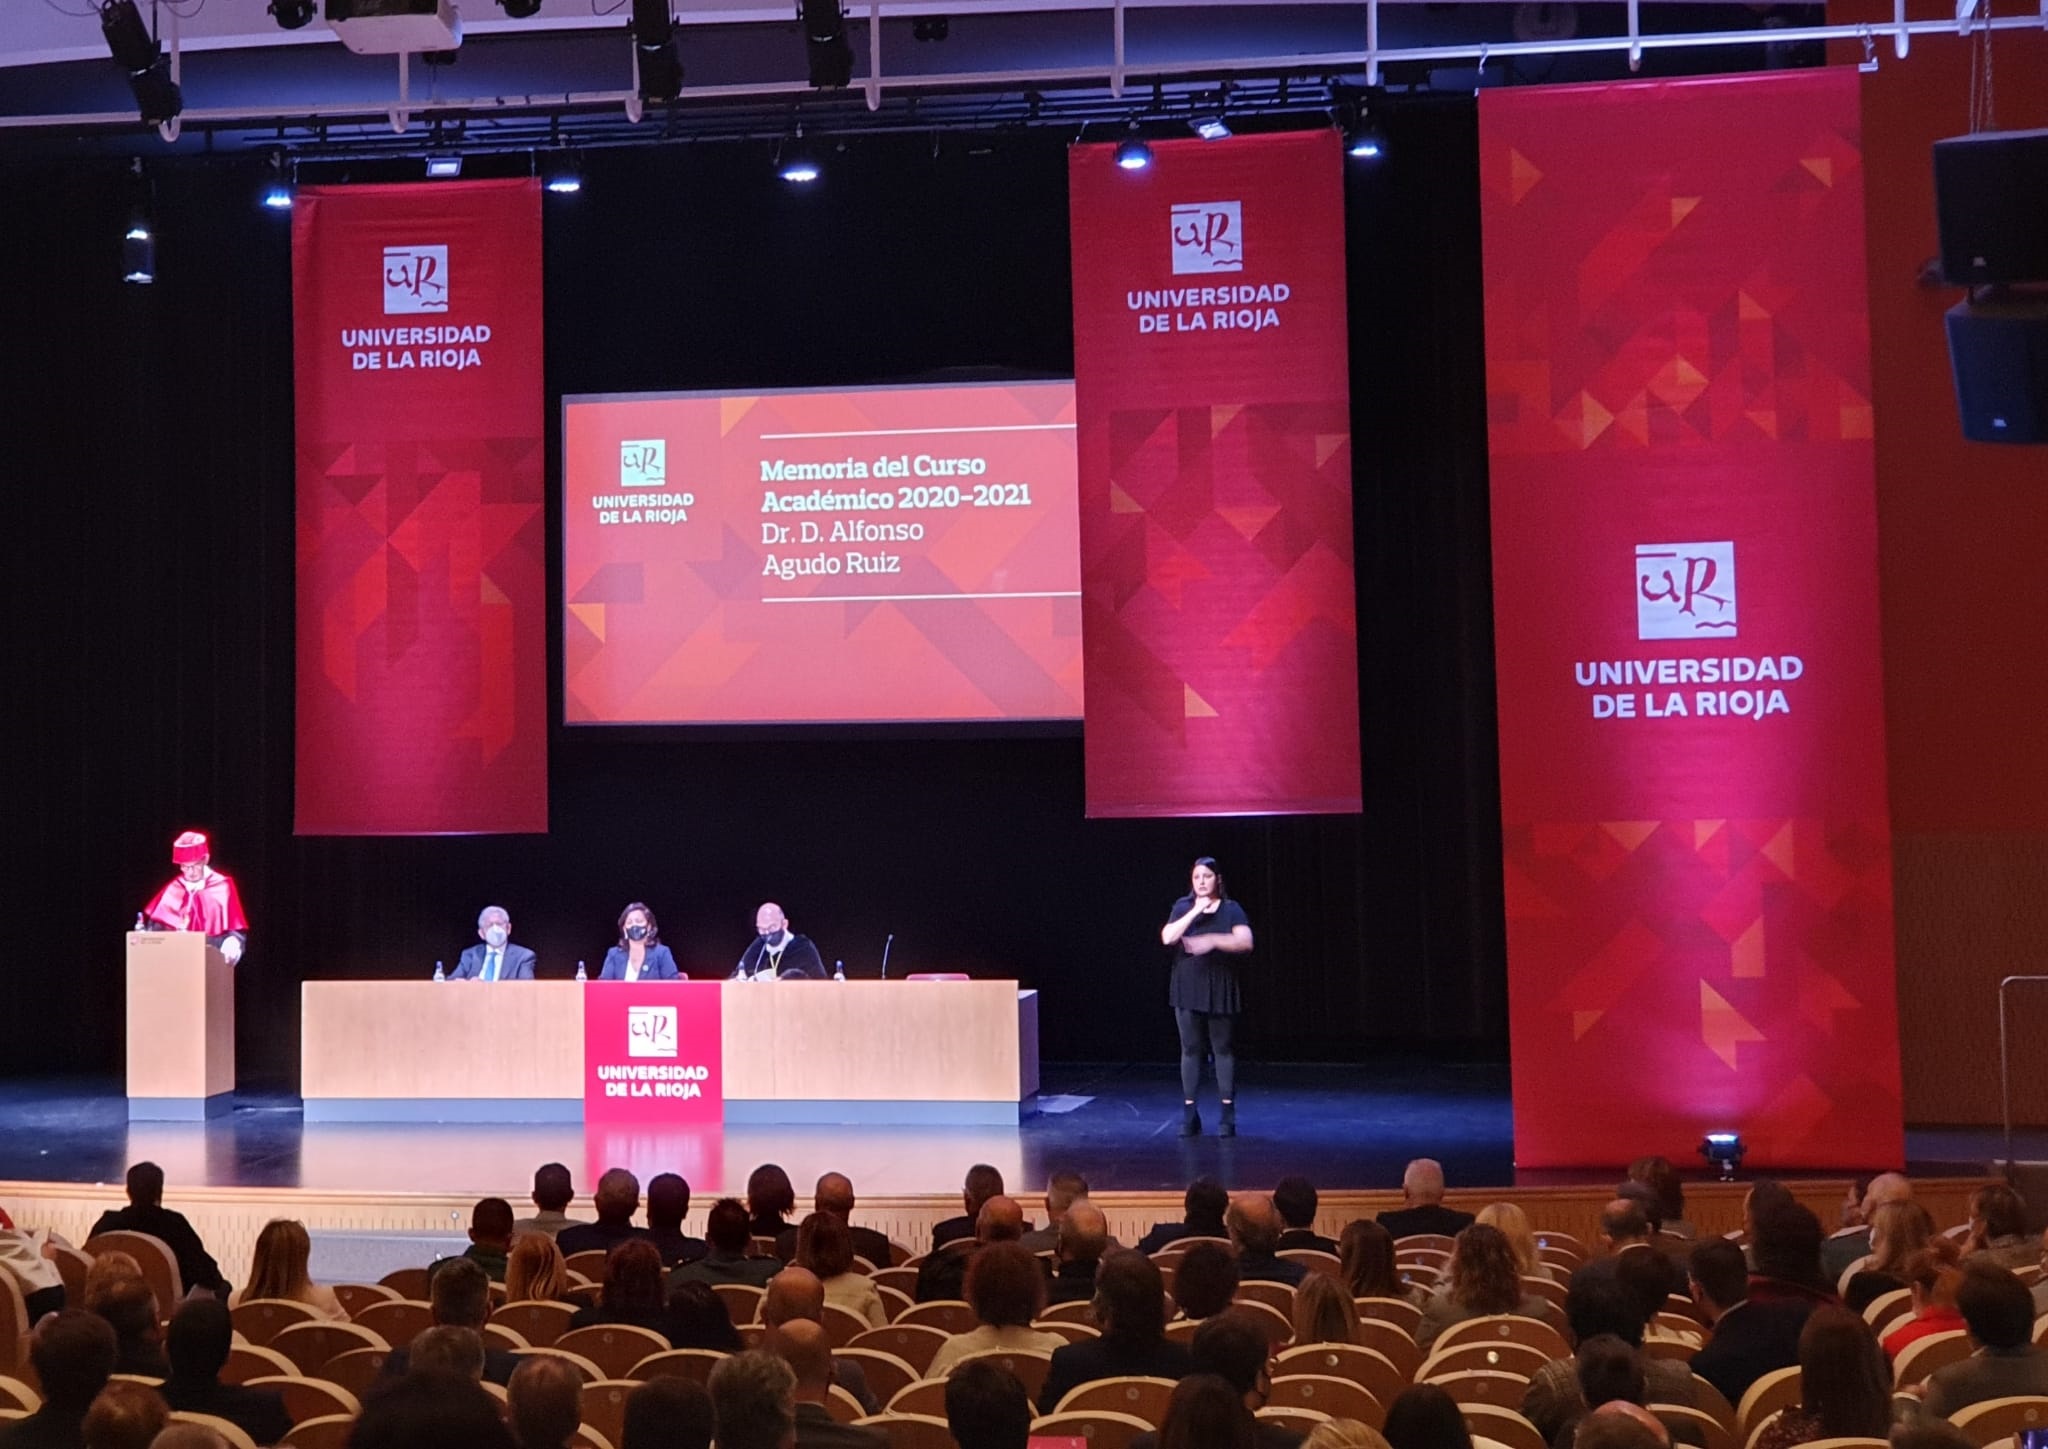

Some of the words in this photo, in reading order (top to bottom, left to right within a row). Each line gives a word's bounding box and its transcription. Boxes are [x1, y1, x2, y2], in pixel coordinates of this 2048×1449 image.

[1127, 284, 1290, 310] UNIVERSIDAD
[1139, 314, 1170, 333] DE
[1177, 312, 1207, 331] LA
[1213, 308, 1280, 332] RIOJA
[341, 325, 491, 347] UNIVERSIDAD
[352, 352, 381, 370] DE
[387, 351, 415, 368] LA
[420, 349, 481, 370] RIOJA
[760, 457, 868, 481] Memoria
[873, 456, 910, 478] del
[914, 455, 986, 476] Curso
[592, 493, 694, 509] UNIVERSIDAD
[761, 489, 894, 512] Académico
[600, 511, 620, 524] DE
[623, 510, 642, 523] LA
[645, 509, 688, 525] RIOJA
[762, 522, 795, 544] Dr.
[800, 522, 824, 543] D.
[829, 520, 924, 542] Alfonso
[762, 554, 841, 580] Agudo
[846, 551, 901, 574] Ruiz
[1575, 656, 1804, 686] UNIVERSIDAD
[1593, 694, 1636, 718] DE
[1645, 692, 1688, 718] LA
[1696, 690, 1790, 721] RIOJA
[597, 1065, 709, 1080] UNIVERSIDAD
[605, 1082, 628, 1097] DE
[631, 1082, 653, 1097] LA
[655, 1082, 702, 1100] RIOJA
